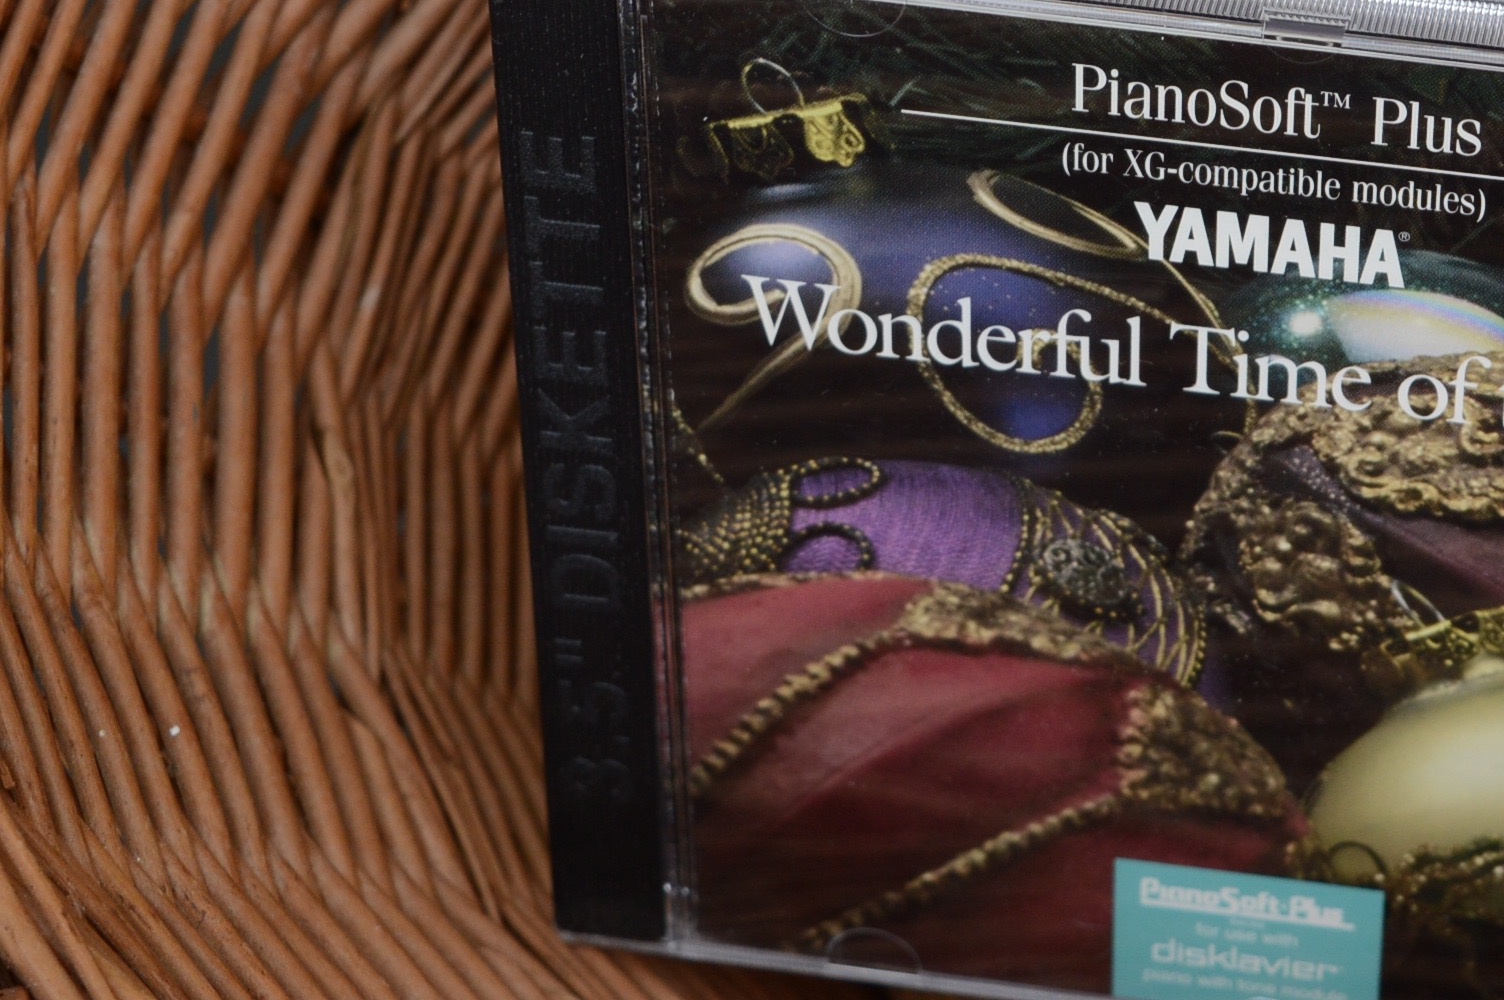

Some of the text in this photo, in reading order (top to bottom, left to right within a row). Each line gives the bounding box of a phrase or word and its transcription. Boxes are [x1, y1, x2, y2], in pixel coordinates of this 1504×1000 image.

[1061, 142, 1487, 223] (for XG-compatible modules)
[1370, 96, 1483, 157] Plus
[520, 129, 621, 614] DISKETTE
[741, 274, 1147, 387] Wonderful
[1169, 322, 1372, 412] Time
[1398, 356, 1492, 425] of
